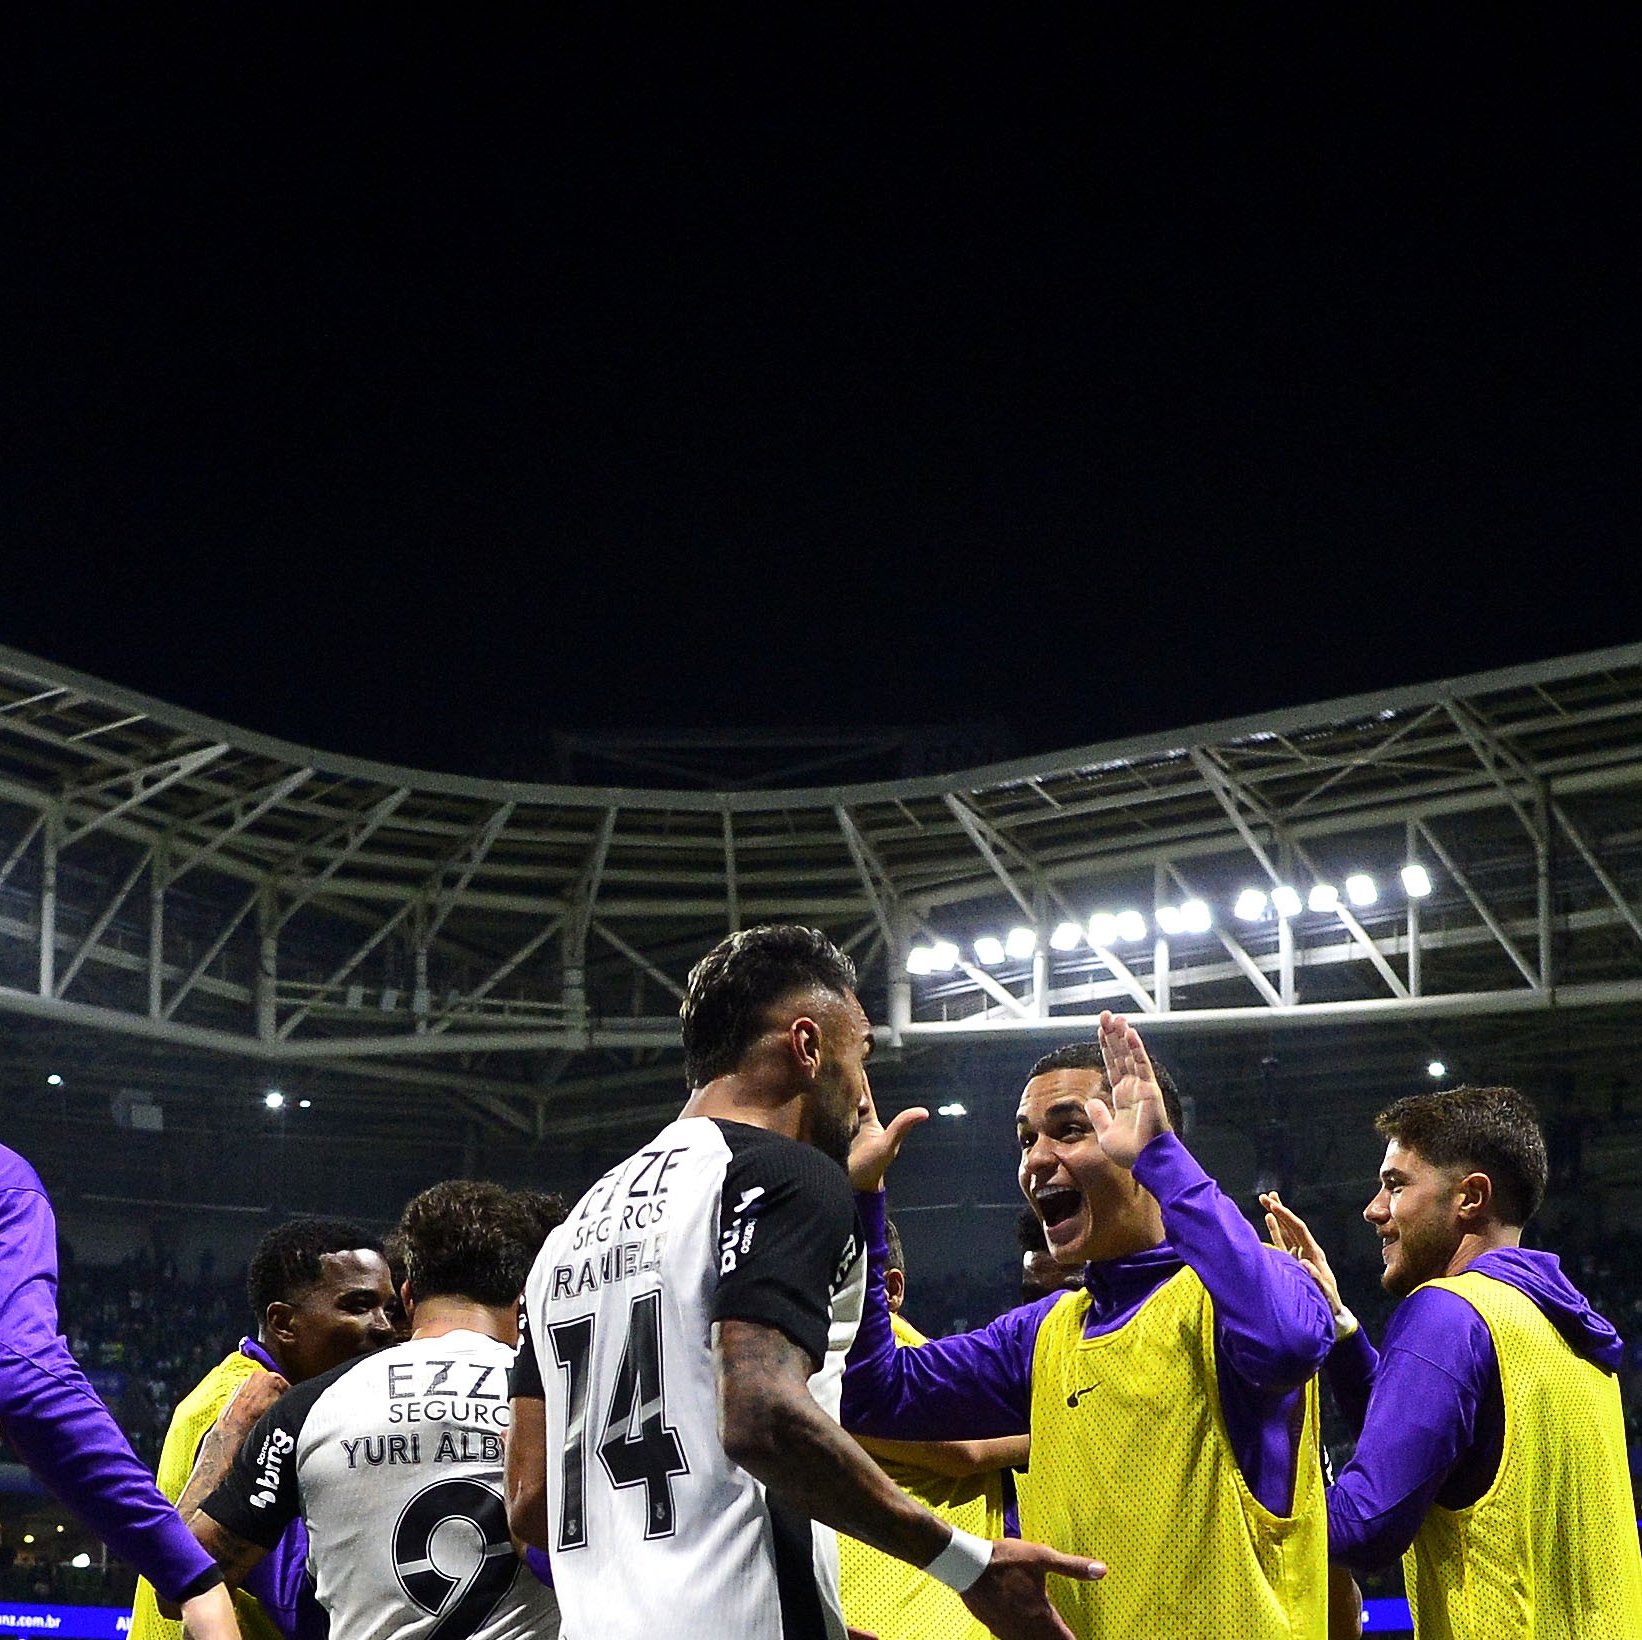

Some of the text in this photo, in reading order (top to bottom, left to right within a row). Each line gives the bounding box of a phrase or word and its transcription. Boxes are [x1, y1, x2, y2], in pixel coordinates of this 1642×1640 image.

[388, 1400, 511, 1428] SEGURO
[548, 1288, 689, 1552] 14
[340, 1432, 422, 1468] YURI
